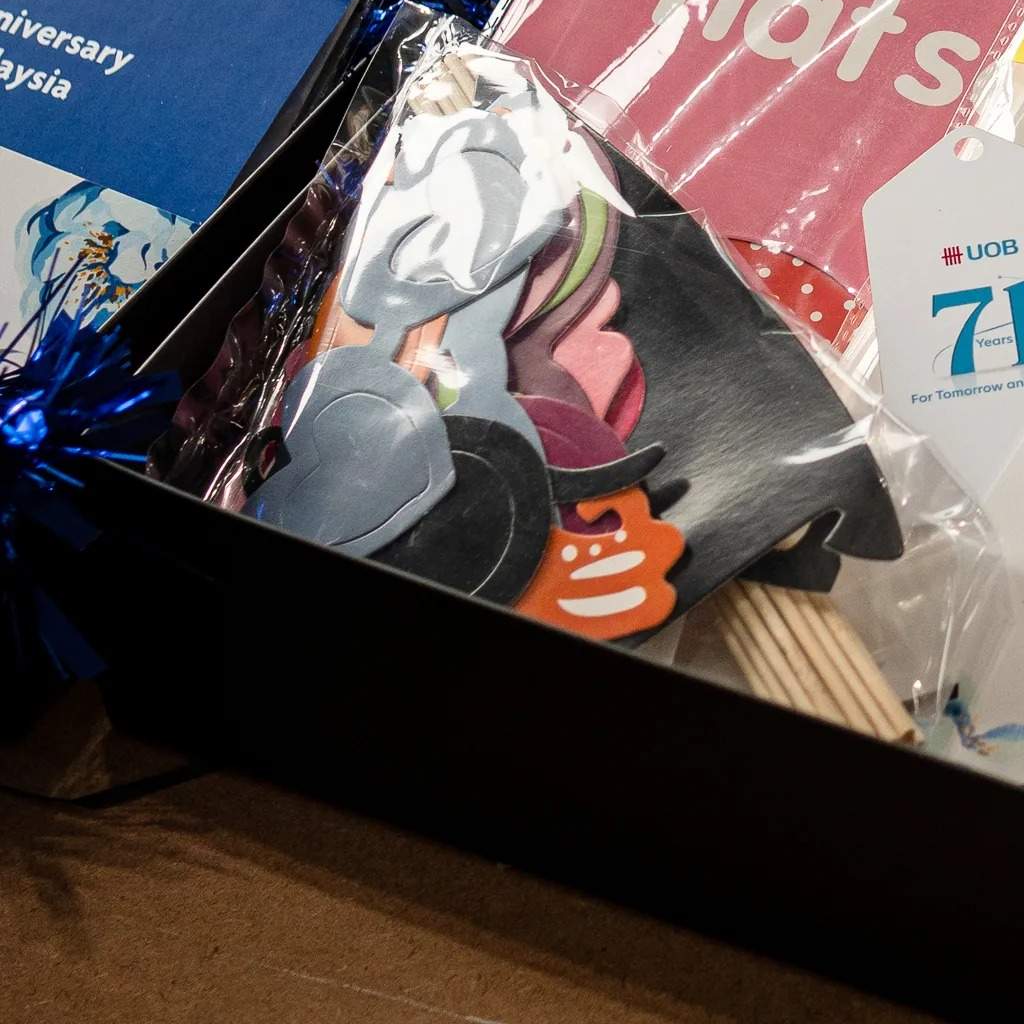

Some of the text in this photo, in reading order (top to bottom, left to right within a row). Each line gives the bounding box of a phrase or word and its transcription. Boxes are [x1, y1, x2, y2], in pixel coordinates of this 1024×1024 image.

[0, 47, 72, 101] aysia
[966, 239, 1018, 261] UOB
[976, 334, 1014, 349] Years
[911, 393, 932, 404] For
[935, 381, 1004, 400] Tomorrow
